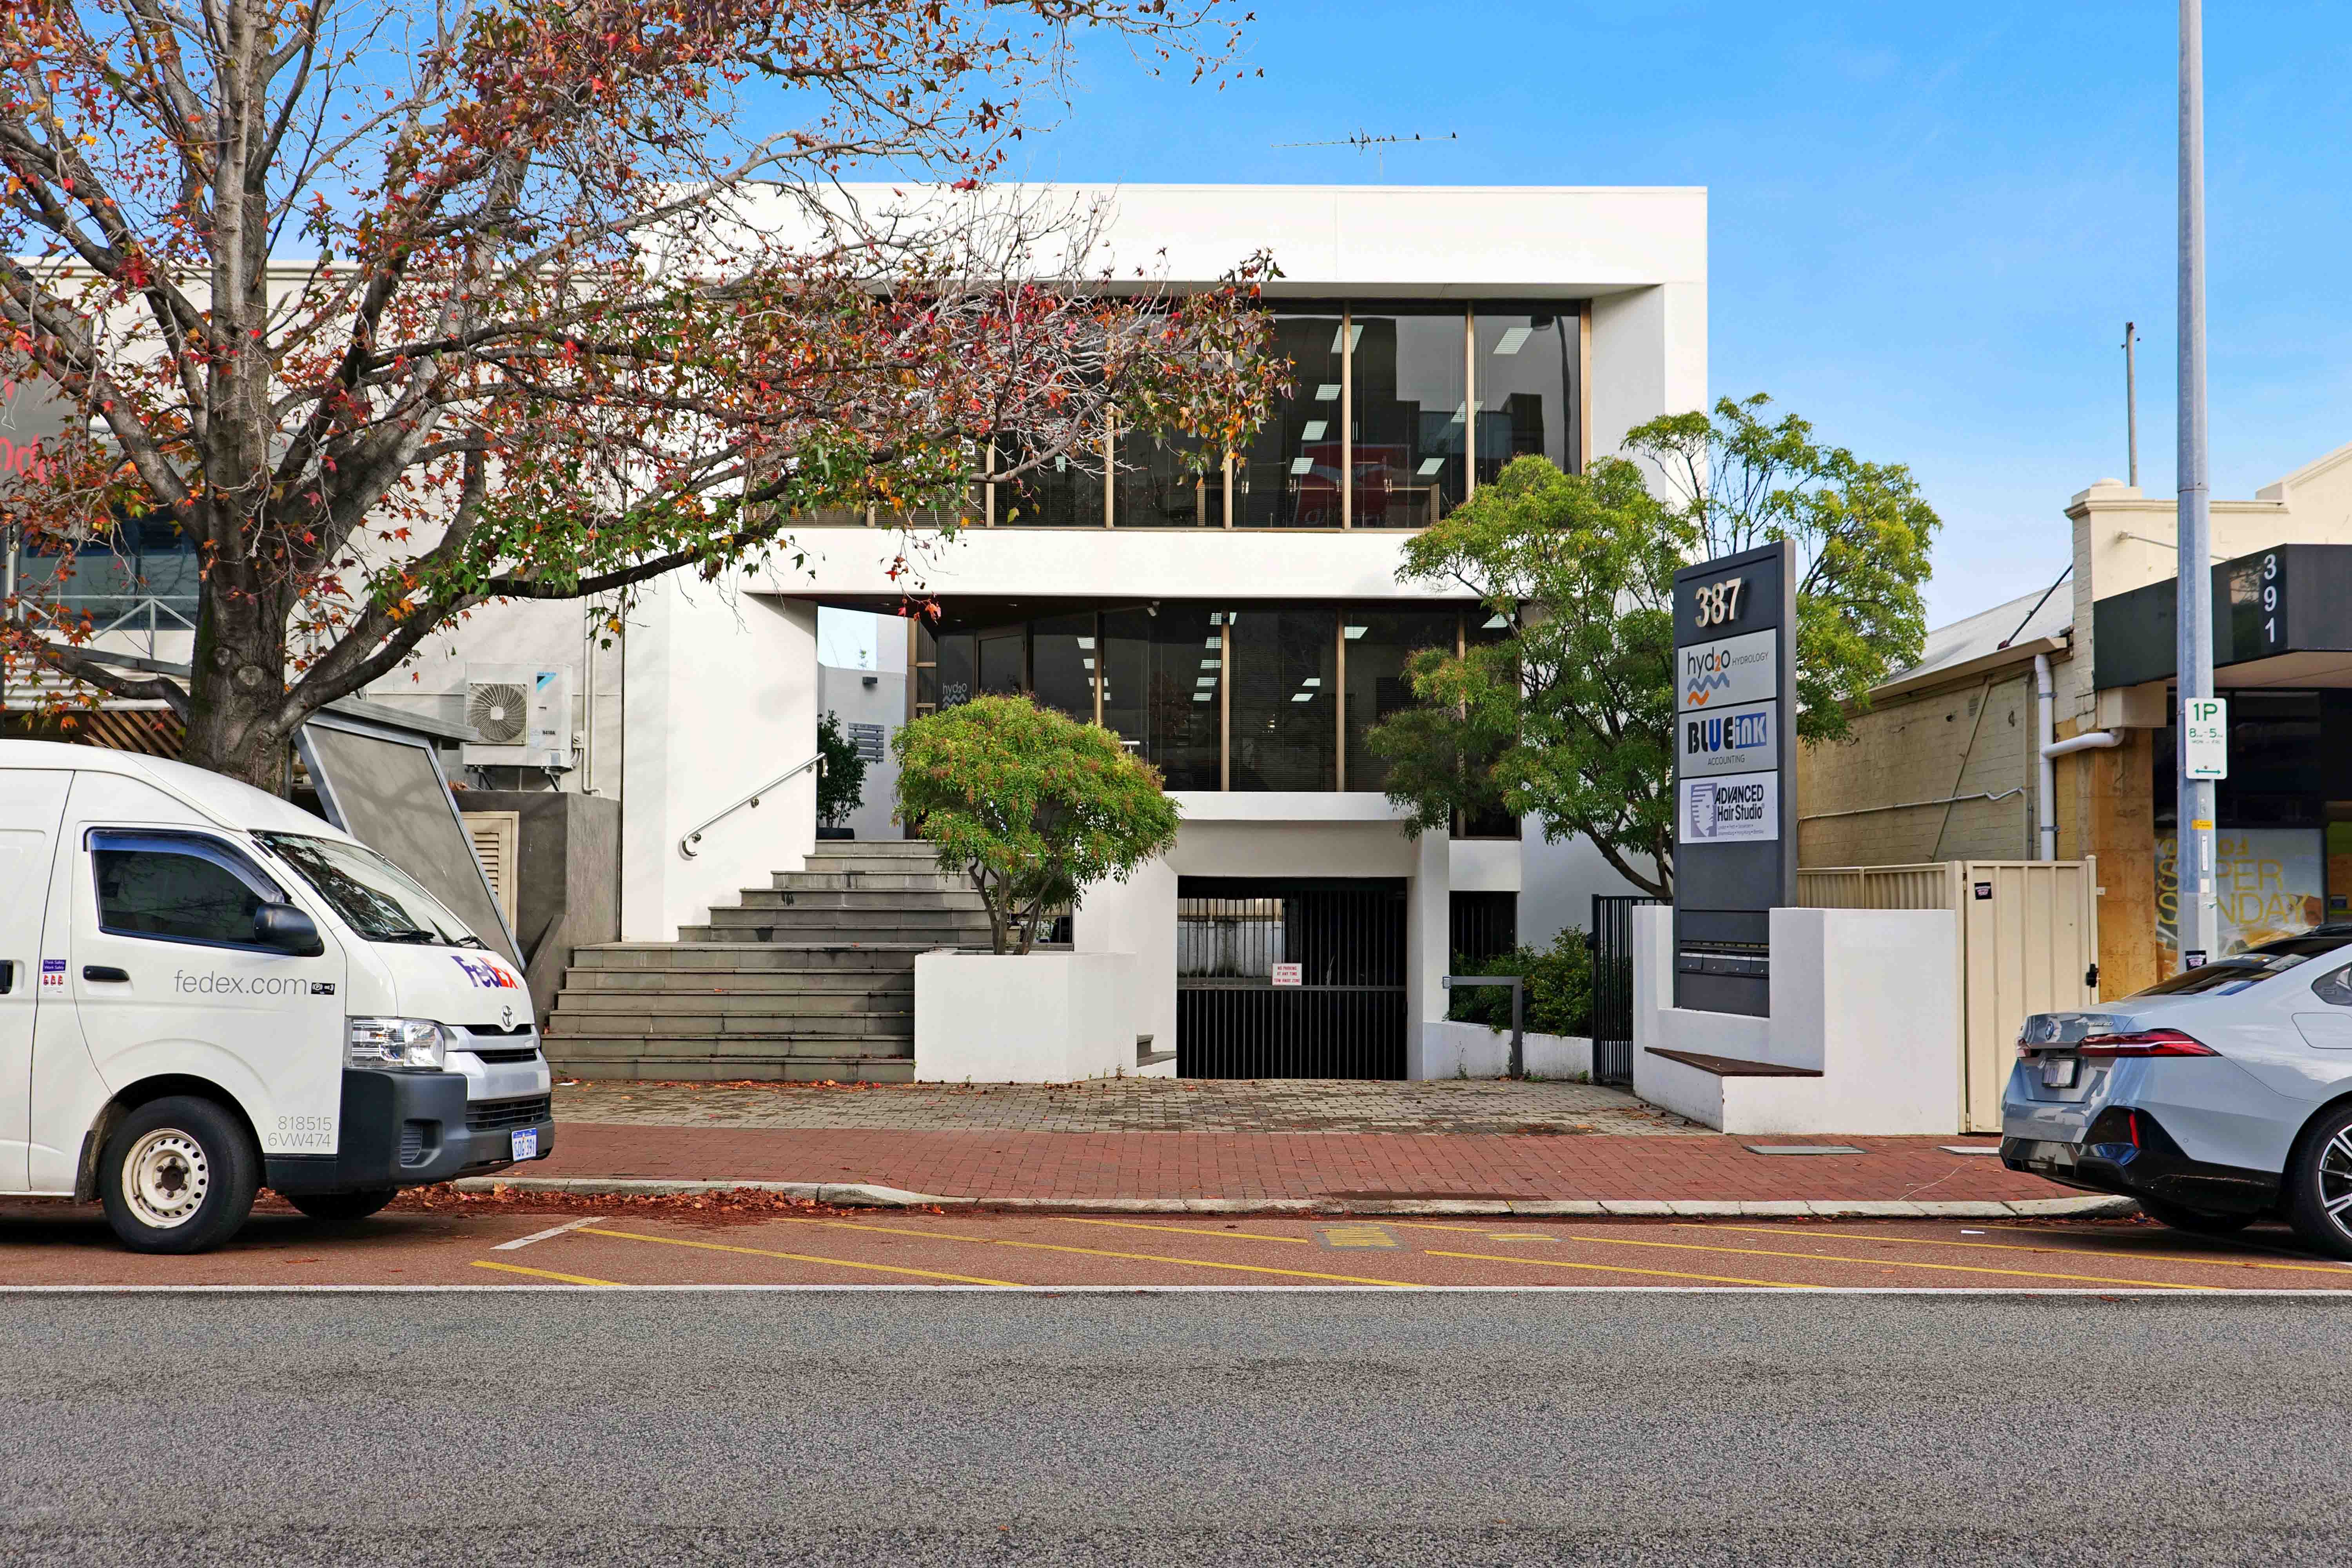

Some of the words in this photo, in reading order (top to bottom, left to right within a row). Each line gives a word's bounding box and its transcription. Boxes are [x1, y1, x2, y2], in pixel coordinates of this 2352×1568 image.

[1695, 577, 1741, 628] 387
[2264, 554, 2277, 643] 391
[1688, 647, 1731, 679] hyd2o
[1732, 651, 1769, 666] HYDROLOGY
[2194, 703, 2218, 721] 1P
[1707, 754, 1745, 765] ACCOUNTING
[1714, 784, 1764, 804] ADVANCED
[1718, 805, 1734, 821] Hair
[1735, 804, 1762, 820] Studio
[2158, 858, 2284, 891] SPER
[2158, 892, 2310, 926] SNDAY
[174, 970, 307, 995] fedex.com
[450, 956, 519, 989] FedEx
[278, 1116, 332, 1131] 818515
[268, 1132, 331, 1147] 6VW474
